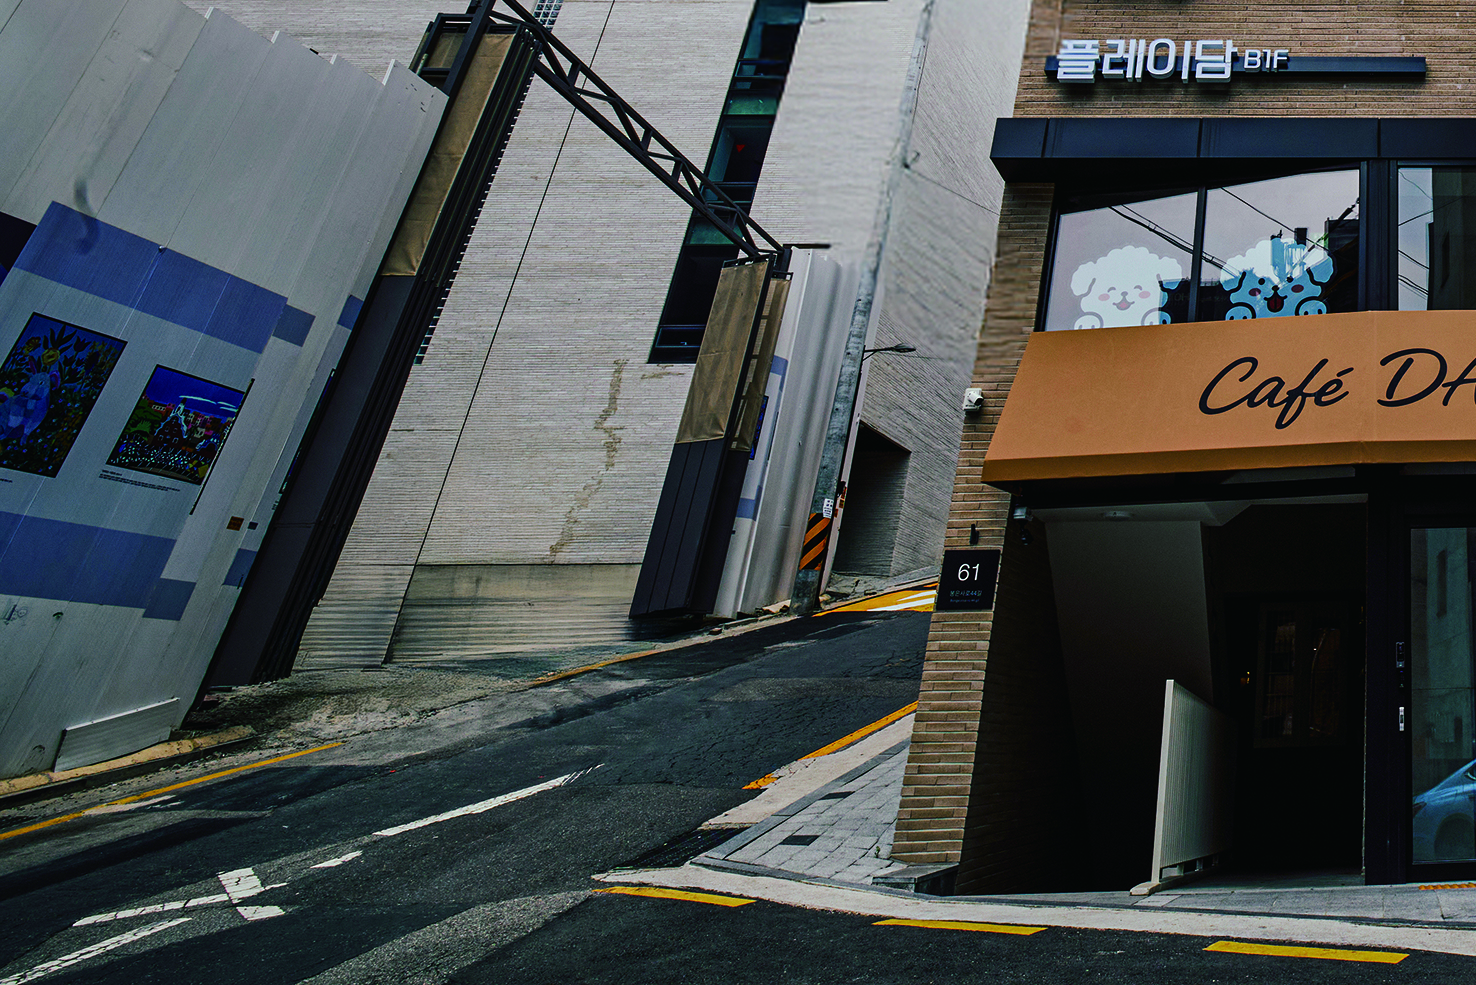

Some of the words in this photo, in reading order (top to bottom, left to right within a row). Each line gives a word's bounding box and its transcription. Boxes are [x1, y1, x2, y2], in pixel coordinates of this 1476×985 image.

[1057, 38, 1239, 84] 플레이담
[1244, 49, 1290, 73] B1F
[1198, 356, 1355, 430] Café
[957, 563, 980, 581] 61
